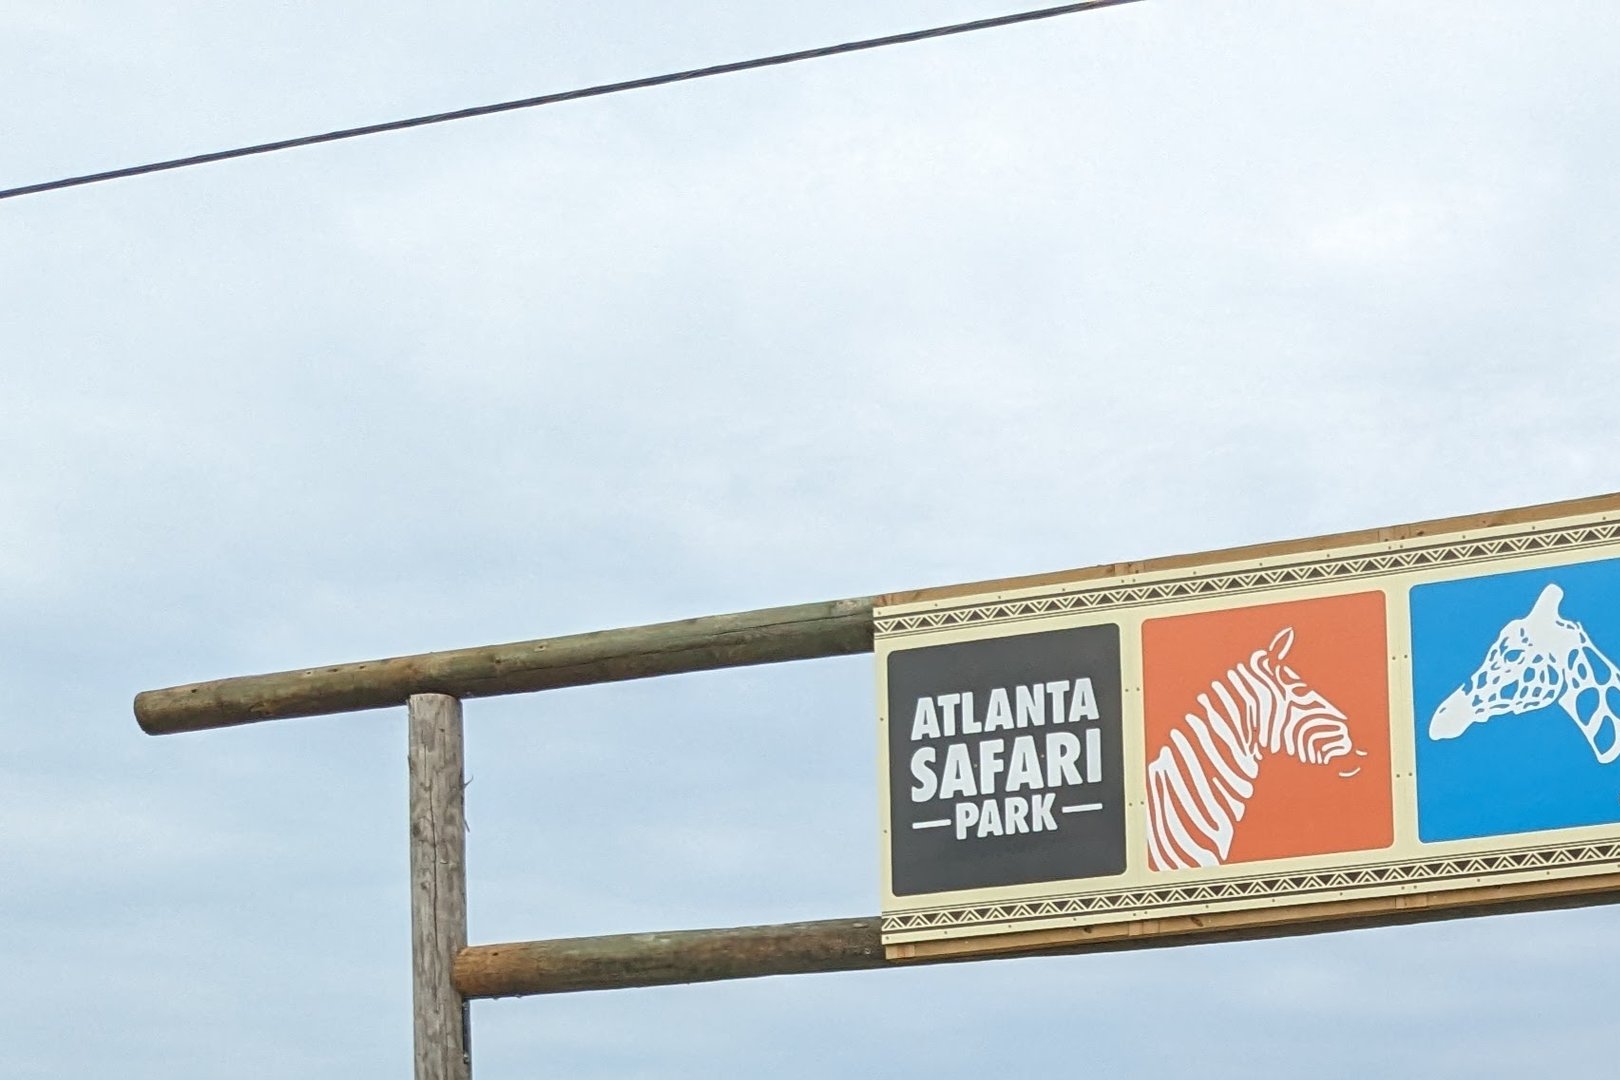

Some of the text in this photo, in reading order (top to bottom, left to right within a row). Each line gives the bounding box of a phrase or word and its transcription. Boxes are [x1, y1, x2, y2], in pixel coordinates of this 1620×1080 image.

[910, 677, 1100, 741] ATLANTA
[910, 728, 1102, 803] SAFARI
[955, 793, 1058, 840] PARK
